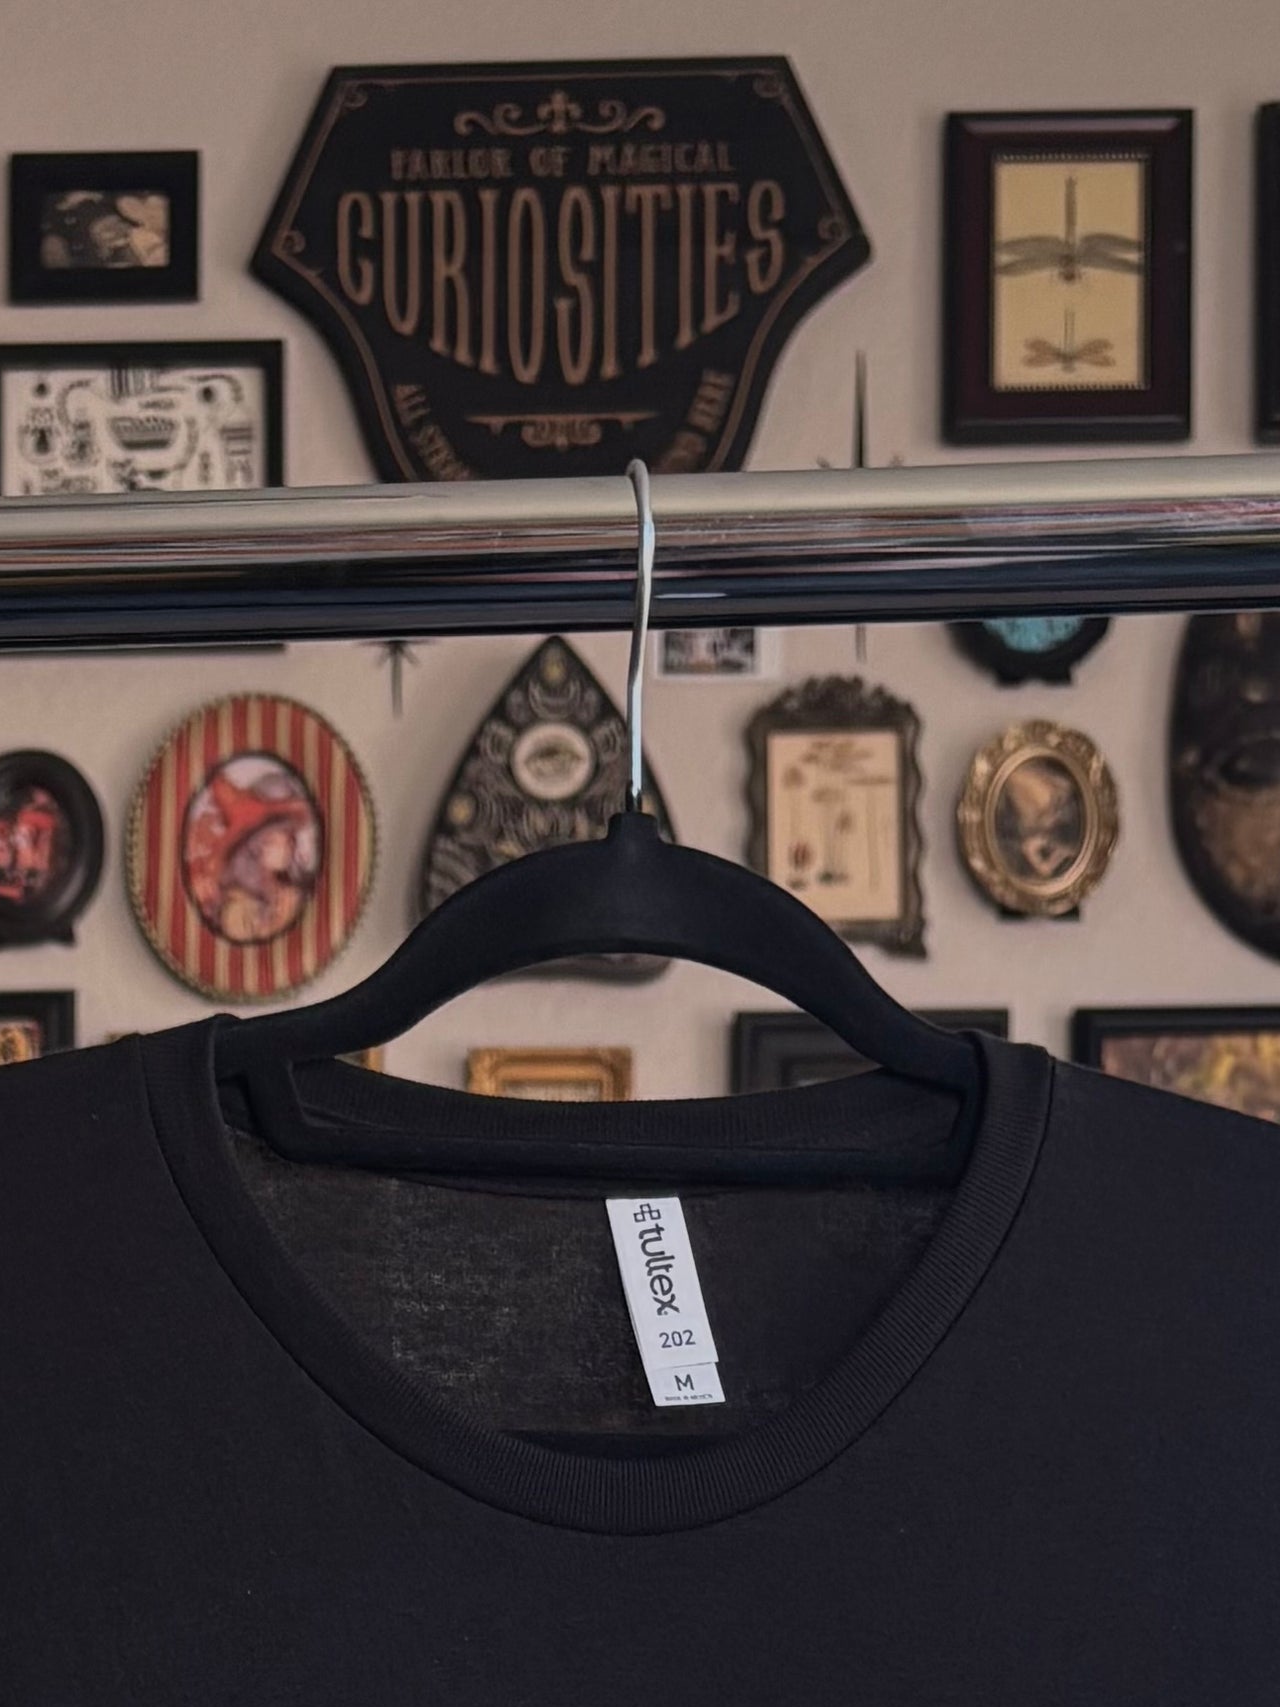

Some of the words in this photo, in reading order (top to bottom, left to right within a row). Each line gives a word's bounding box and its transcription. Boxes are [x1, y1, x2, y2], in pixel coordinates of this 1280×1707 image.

[528, 146, 569, 178] OF
[587, 141, 735, 176] MAGICAL
[337, 179, 786, 385] CURIOSITIES
[638, 1222, 681, 1317] tultex
[658, 1328, 697, 1349] 202
[673, 1373, 696, 1392] M
